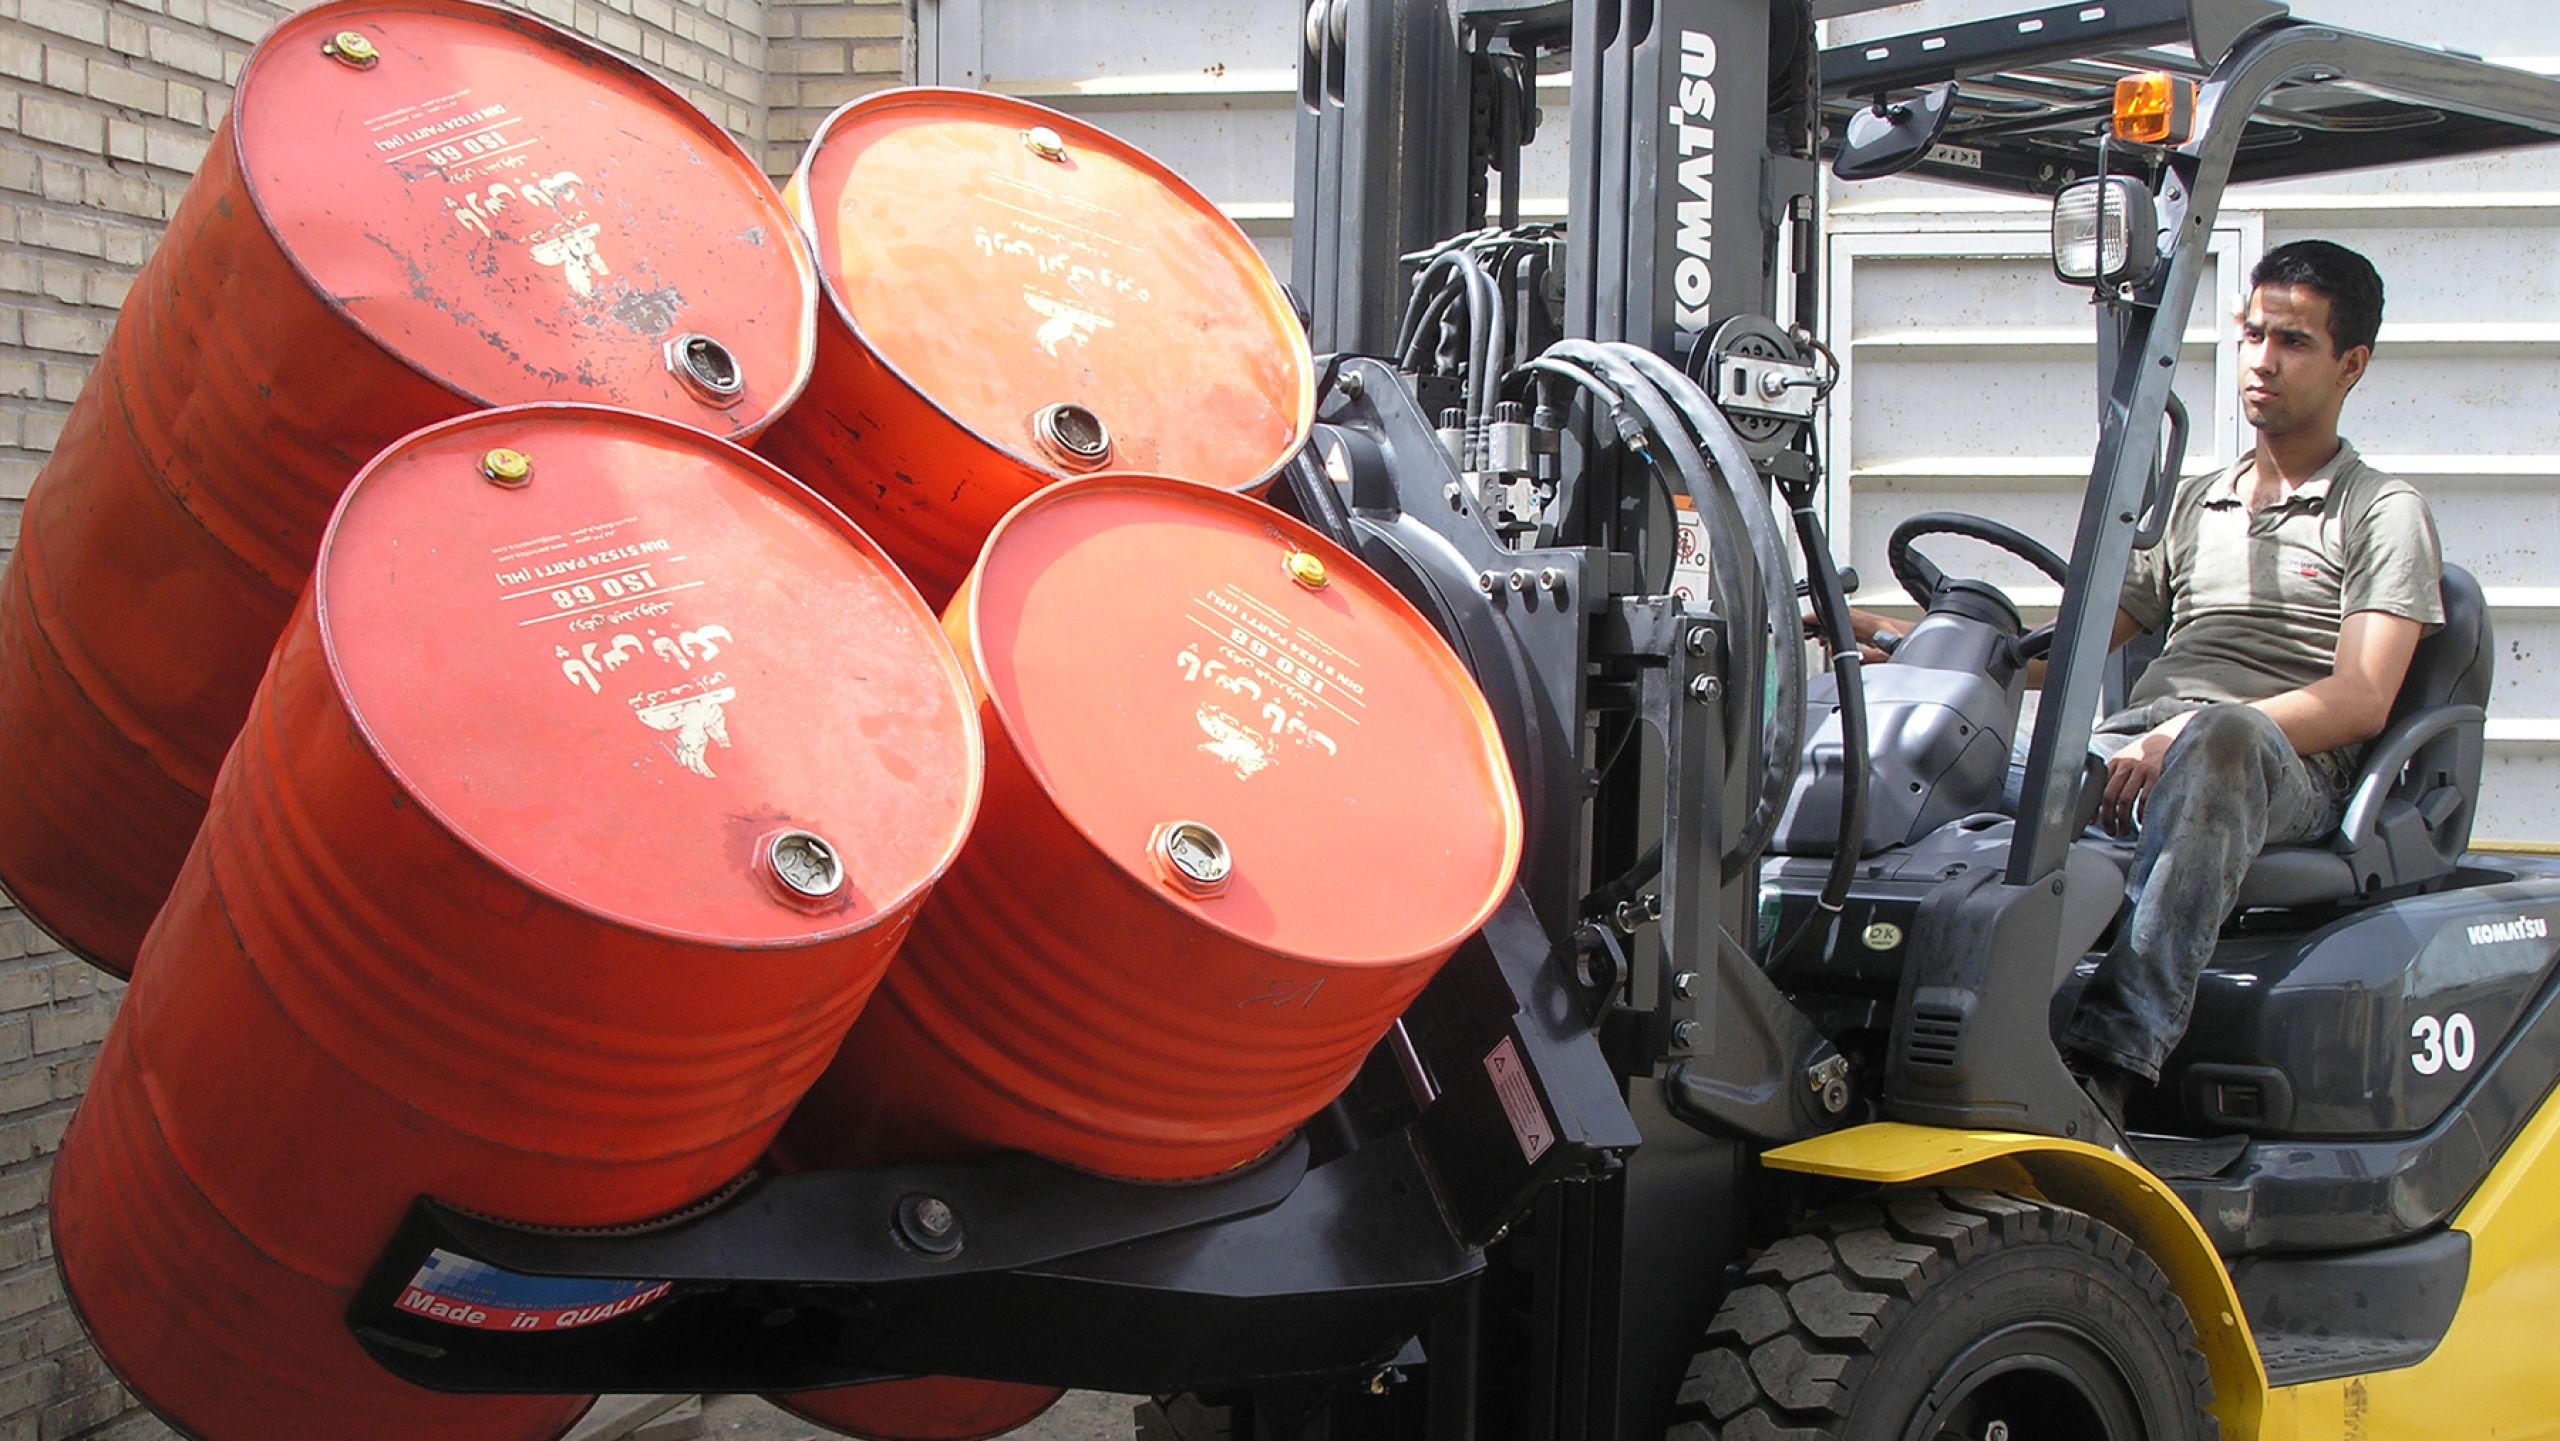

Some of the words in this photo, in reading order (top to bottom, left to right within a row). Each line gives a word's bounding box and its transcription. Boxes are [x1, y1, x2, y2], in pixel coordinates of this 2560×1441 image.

[424, 145, 463, 166] 68
[462, 130, 509, 155] ISO
[1669, 29, 1717, 352] KOMATSU
[444, 183, 518, 238] پارس
[588, 544, 641, 566] 51524
[639, 538, 671, 552] DIN
[495, 566, 533, 587] (HL)
[601, 570, 658, 597] ISO
[551, 585, 598, 610] 68
[1230, 627, 1268, 659] 68
[554, 633, 645, 696] پارس
[1176, 642, 1262, 702] پارس
[1275, 655, 1326, 695] ISO
[1870, 927, 1894, 940] OK
[2466, 915, 2548, 946] KOMATSU
[2411, 1012, 2476, 1075] 30
[404, 1289, 487, 1325] Made
[510, 1312, 541, 1329] in
